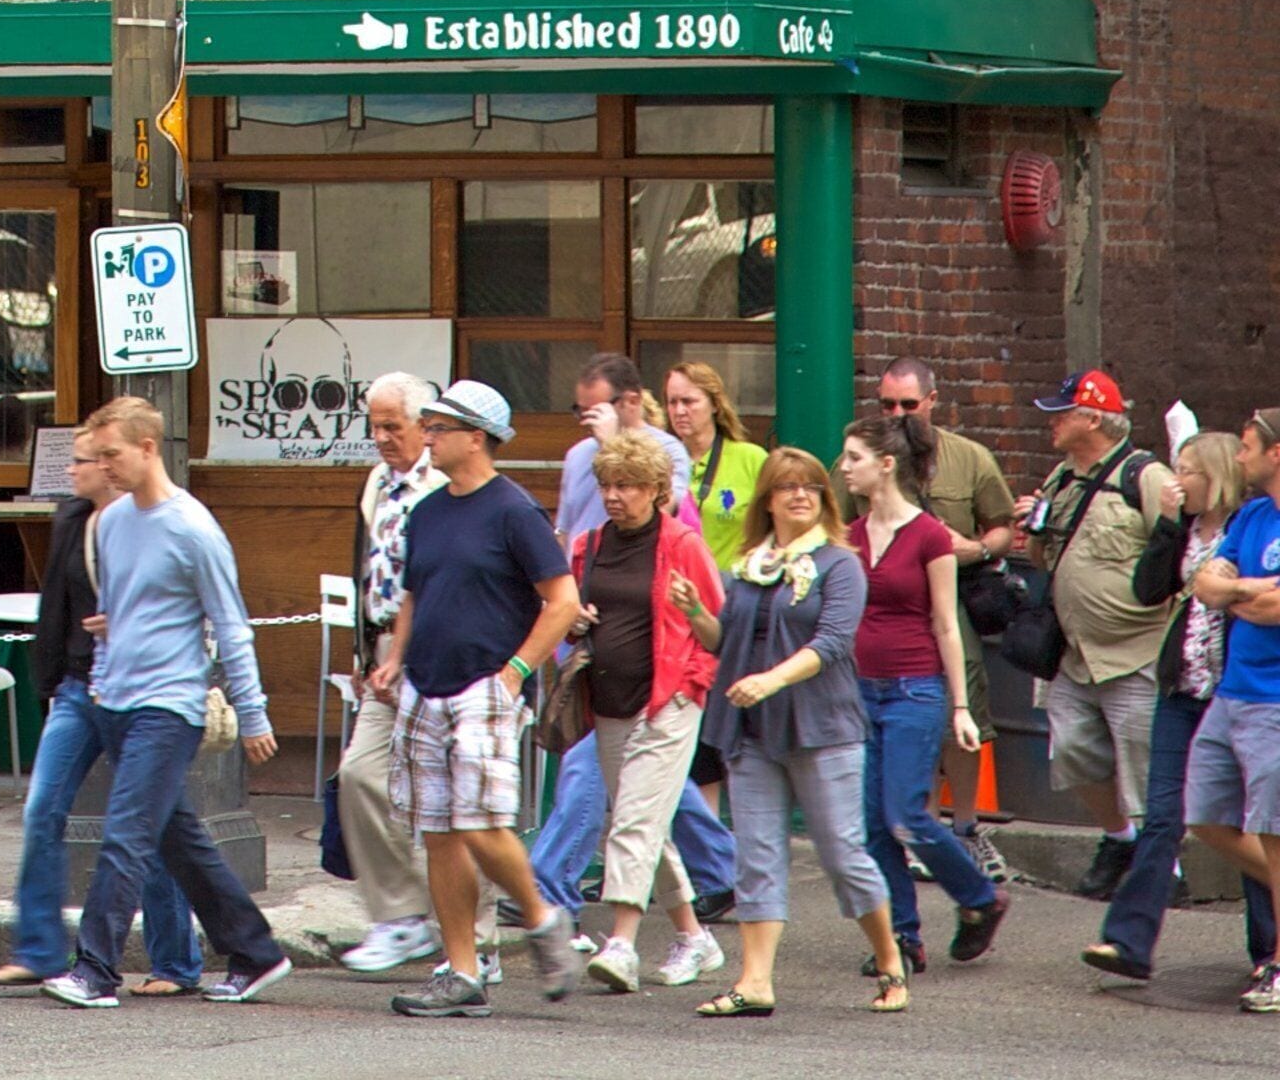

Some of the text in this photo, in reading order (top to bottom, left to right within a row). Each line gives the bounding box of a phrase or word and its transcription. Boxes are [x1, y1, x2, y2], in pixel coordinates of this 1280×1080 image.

[425, 11, 740, 51] Established 1890
[779, 15, 815, 54] Cafe
[135, 119, 149, 188] 103
[127, 292, 156, 307] PAY
[134, 311, 153, 324] TO
[124, 327, 166, 342] PARK
